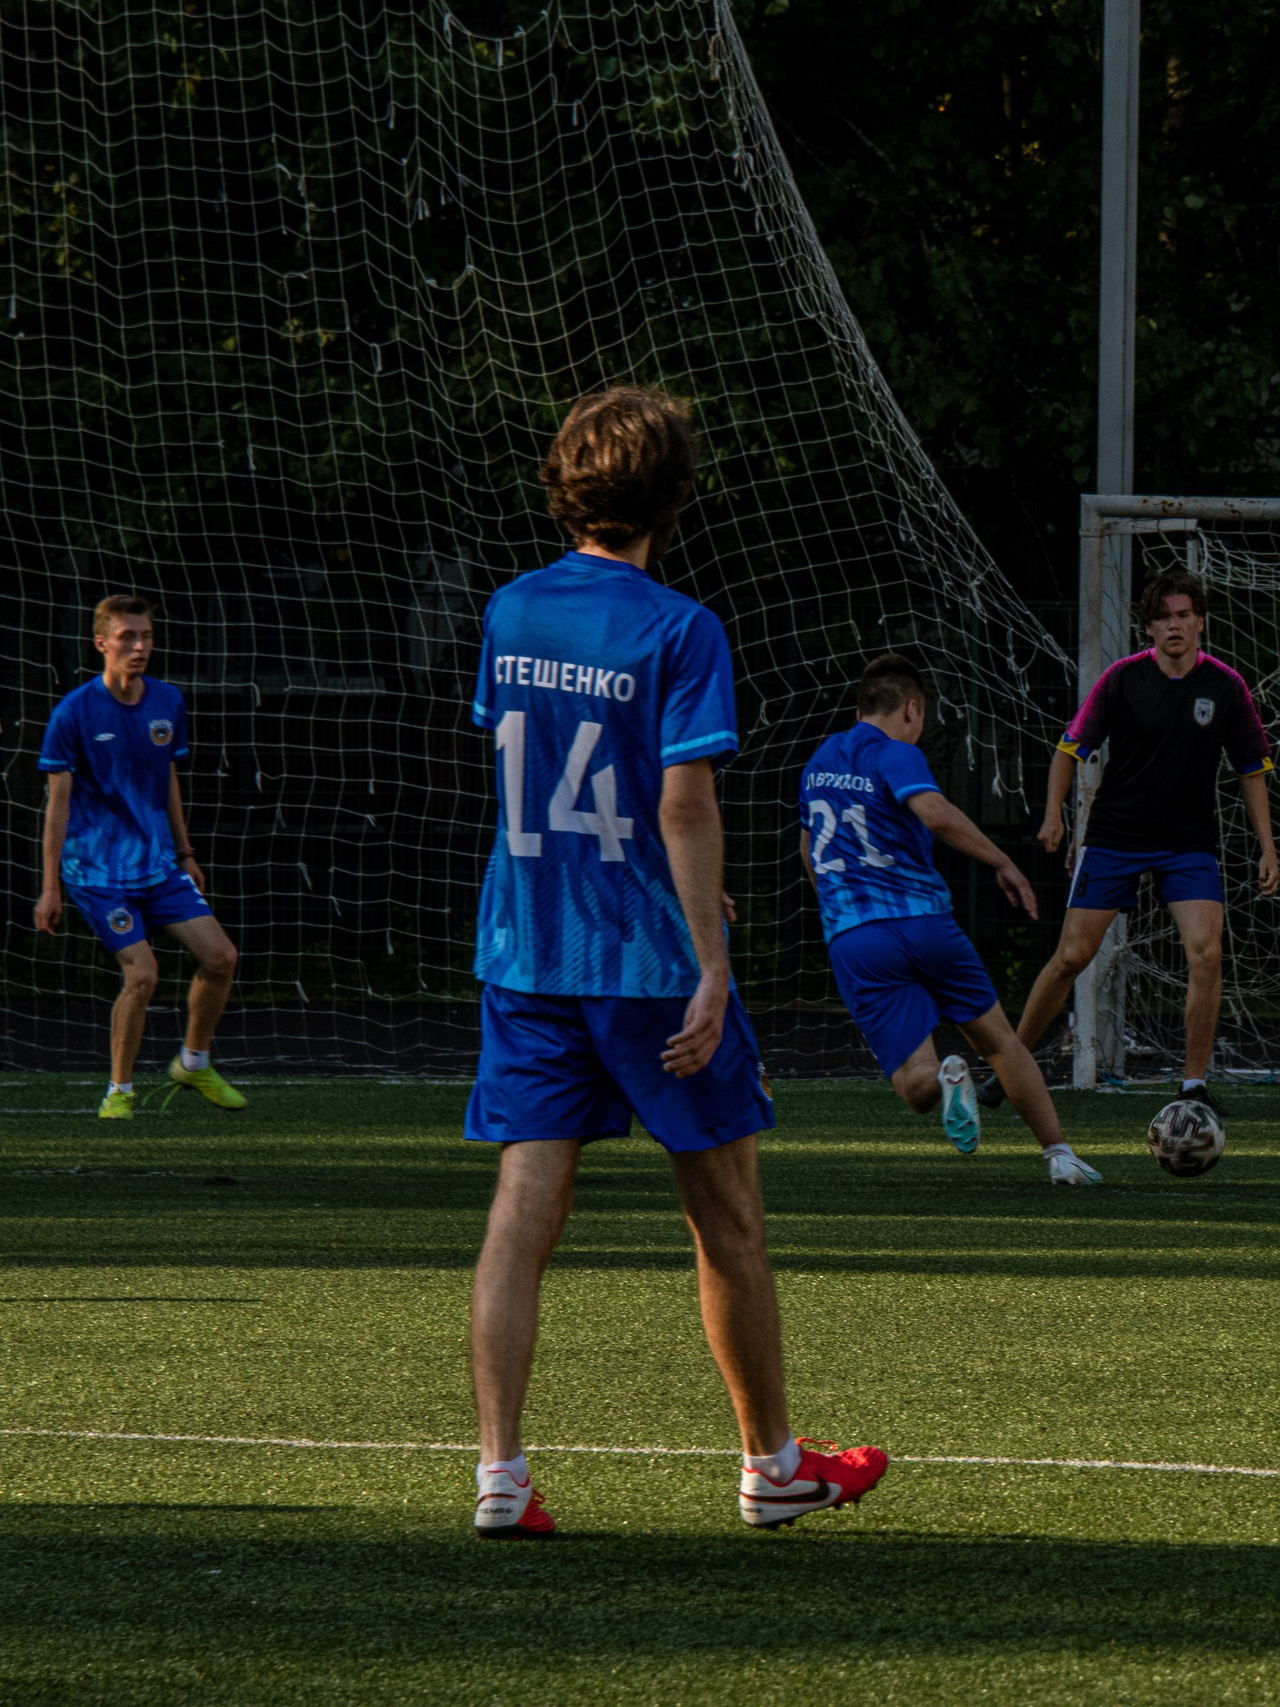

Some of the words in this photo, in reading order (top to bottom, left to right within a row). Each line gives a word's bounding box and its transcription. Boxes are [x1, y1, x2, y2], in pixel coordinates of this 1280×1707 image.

[495, 655, 636, 702] СТЕШЕНКО
[495, 710, 635, 862] 14
[808, 799, 895, 875] 21
